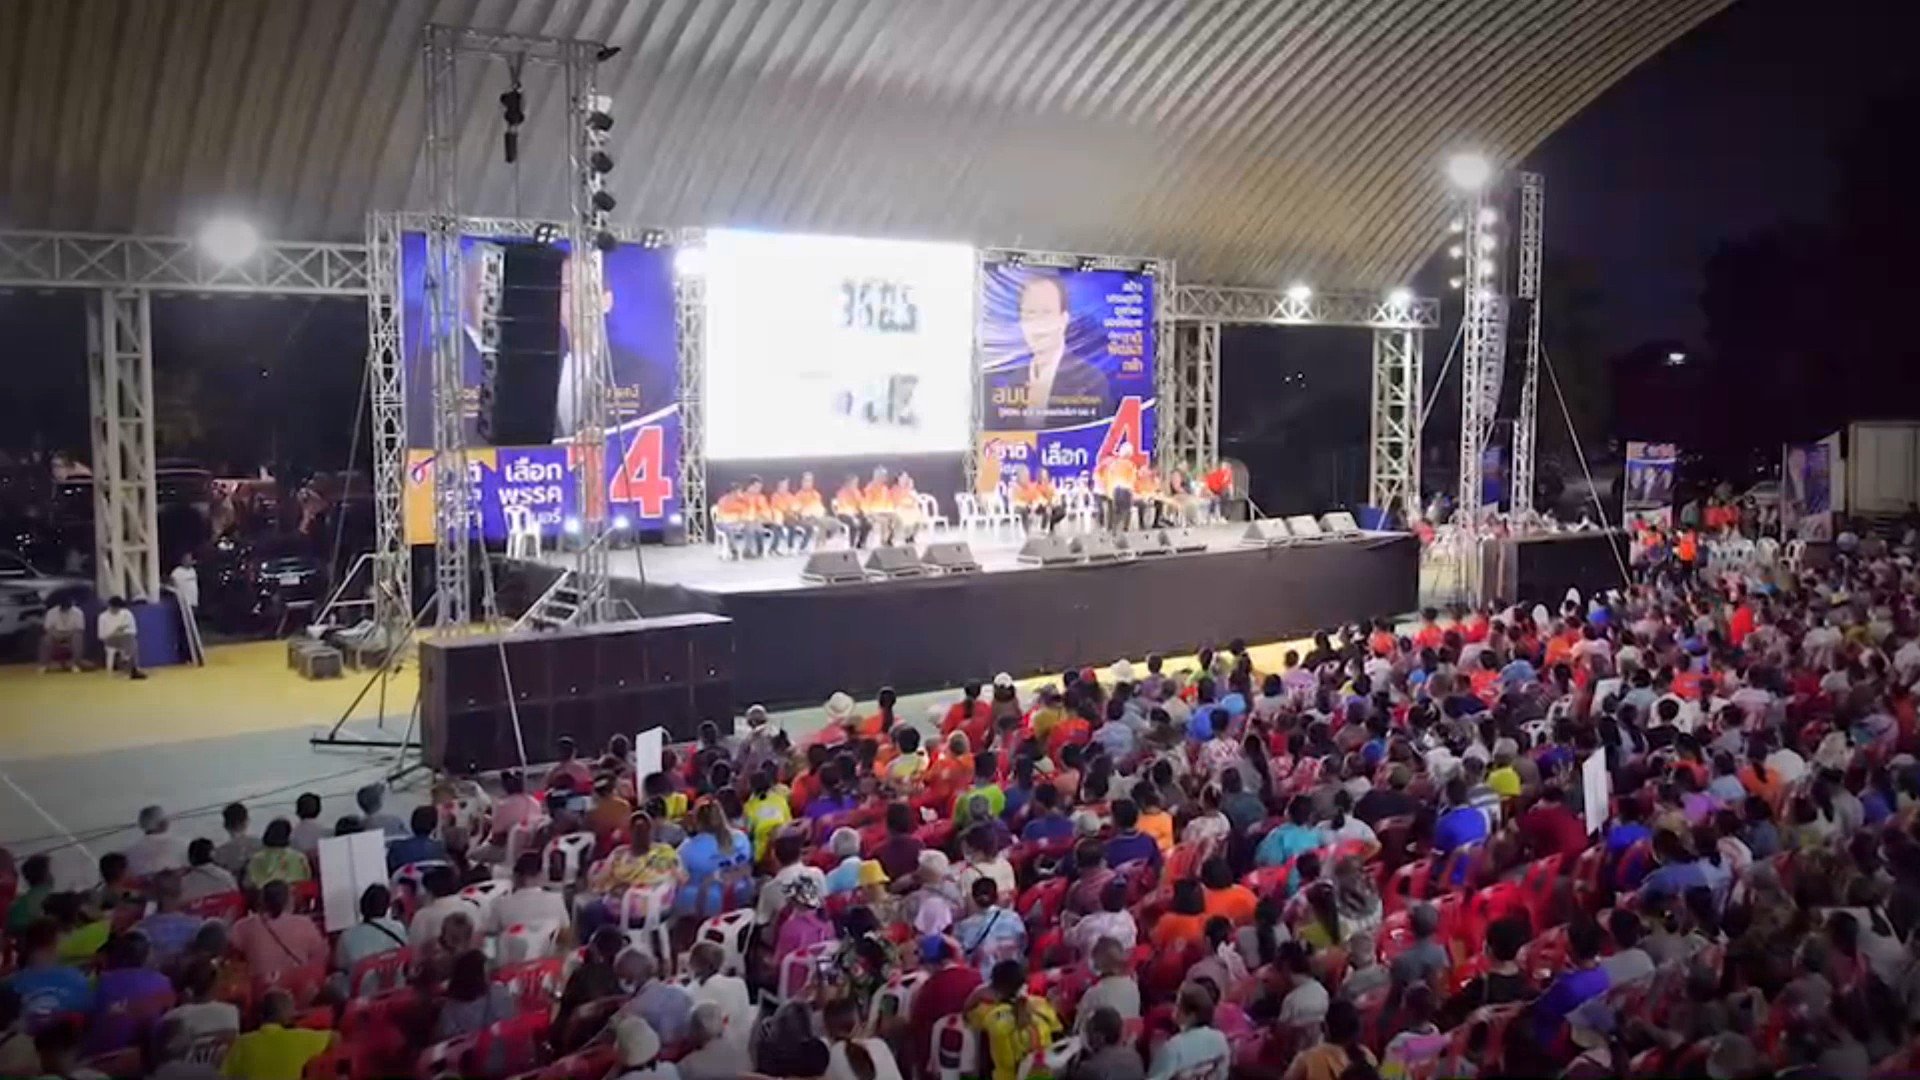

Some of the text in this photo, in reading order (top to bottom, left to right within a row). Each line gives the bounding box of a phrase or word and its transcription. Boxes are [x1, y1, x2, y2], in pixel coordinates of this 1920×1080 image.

[1095, 395, 1150, 468] 4
[1042, 440, 1088, 466] เลือก
[505, 456, 562, 483] เลือก
[498, 485, 563, 506] พรรค
